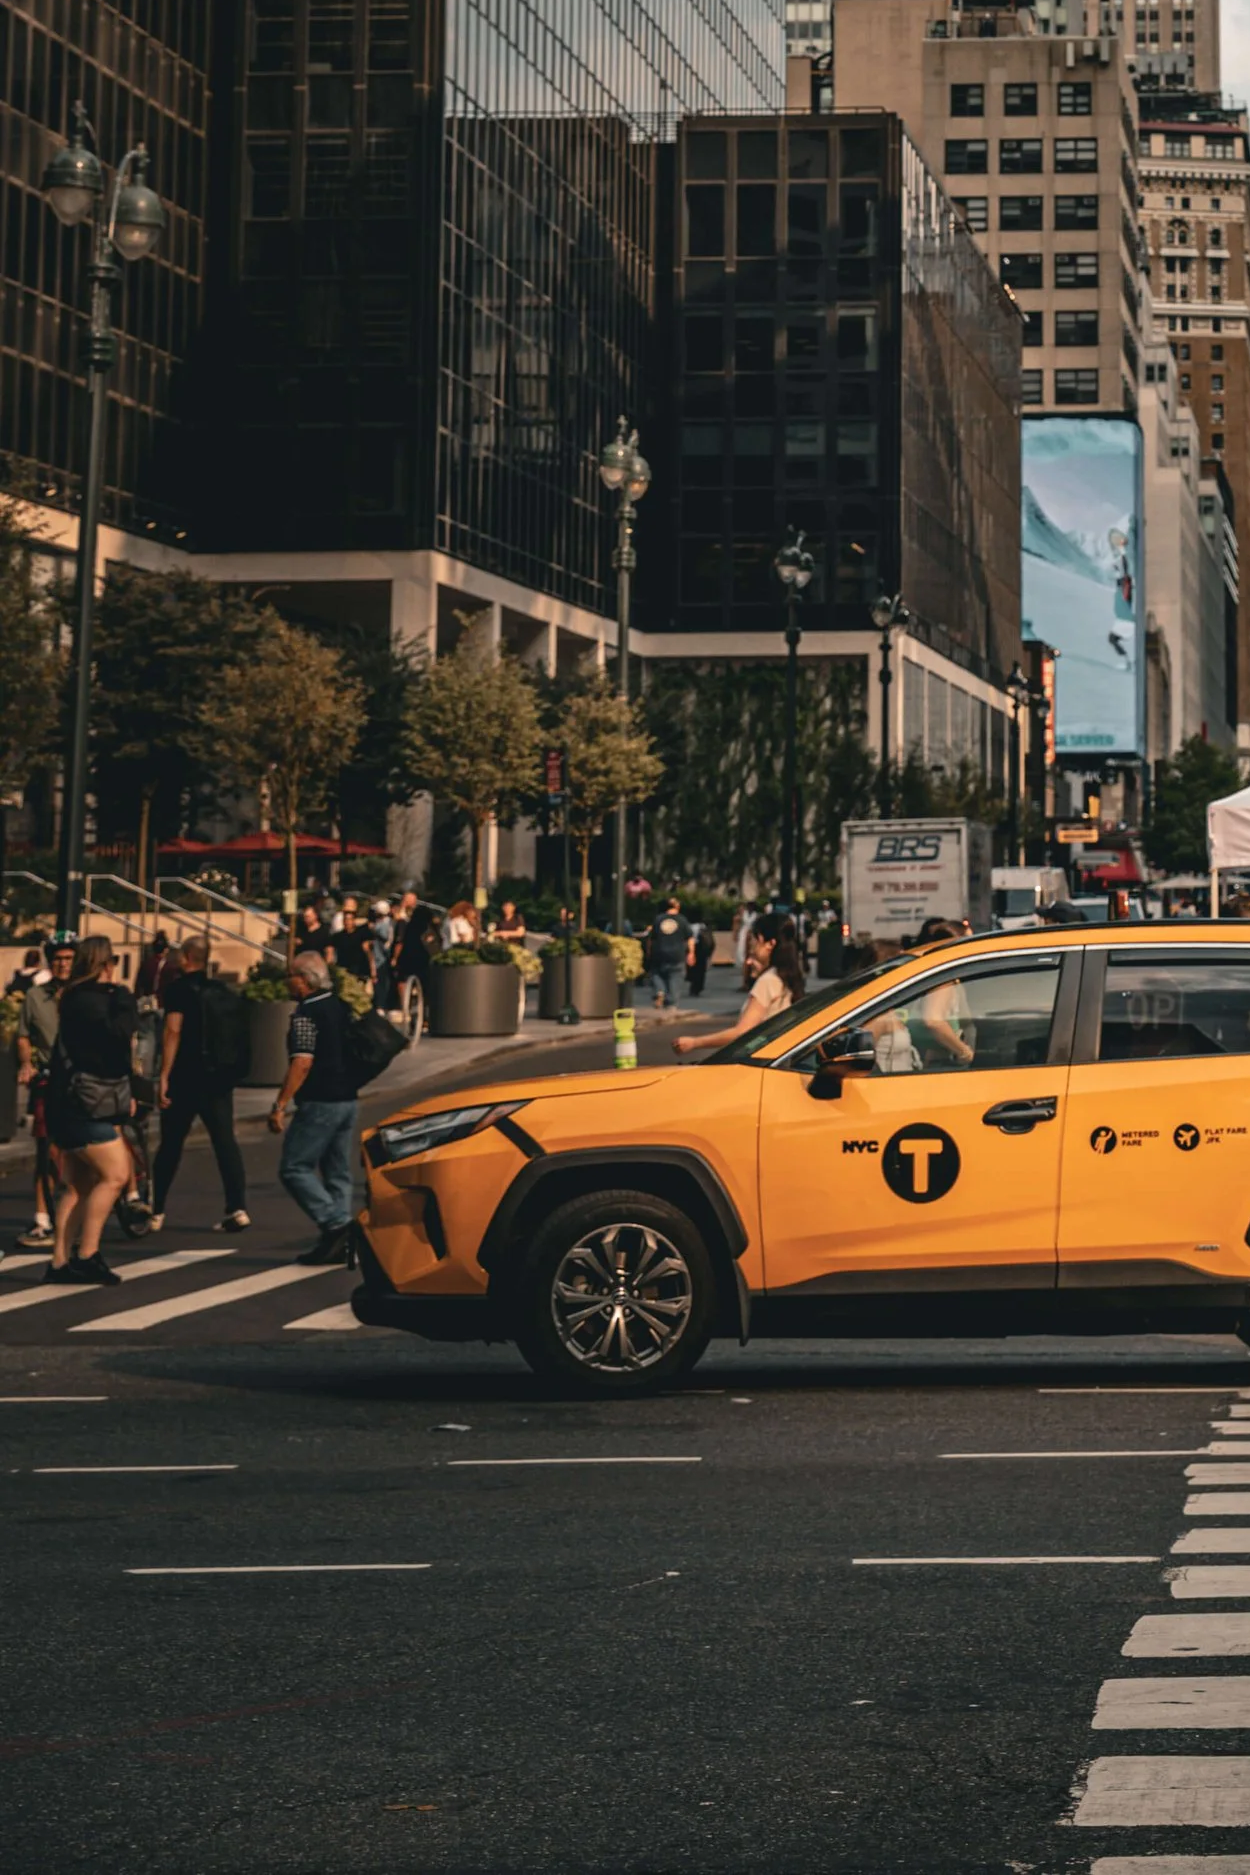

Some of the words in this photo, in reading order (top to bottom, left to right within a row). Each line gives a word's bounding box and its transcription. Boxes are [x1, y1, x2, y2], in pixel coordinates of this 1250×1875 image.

[873, 835, 942, 862] BRS
[1121, 1130, 1159, 1139] METERED
[1205, 1128, 1224, 1136] FLAT
[1227, 1127, 1248, 1135] FARE
[842, 1140, 879, 1153] NYC
[1122, 1139, 1142, 1147] FARE
[899, 1138, 943, 1193] T
